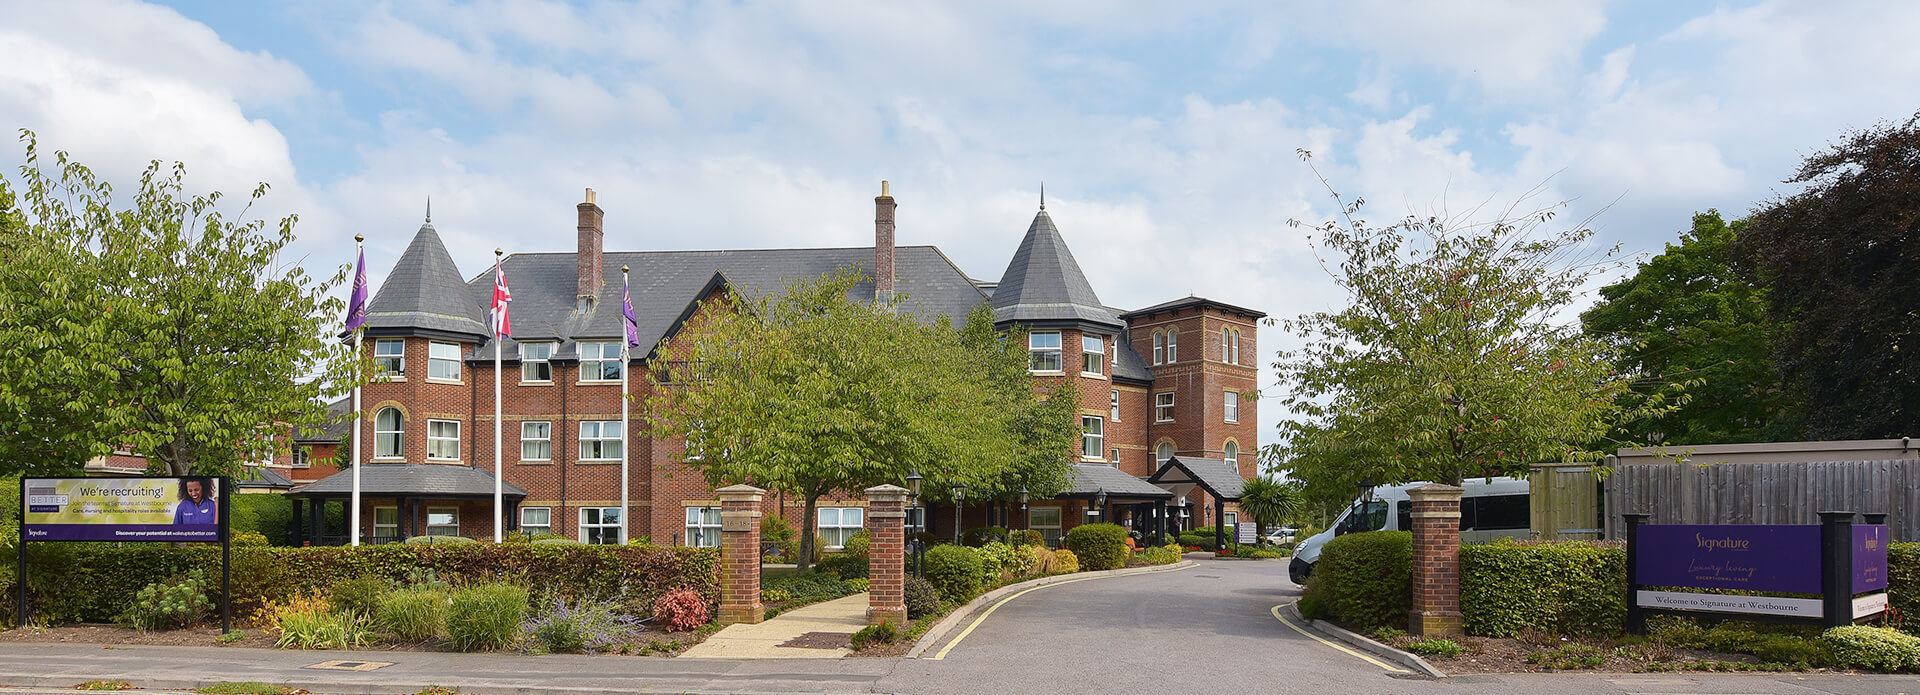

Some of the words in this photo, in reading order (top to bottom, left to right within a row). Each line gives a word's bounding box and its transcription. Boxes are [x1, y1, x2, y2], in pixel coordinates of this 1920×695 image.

[80, 487, 109, 497] We're
[111, 486, 164, 499] recruiting!
[31, 496, 67, 504] BETTER
[28, 528, 47, 537] Signature
[1696, 532, 1749, 552] Signature
[1655, 596, 1688, 605] Welcome
[1700, 598, 1736, 609] Signature
[1748, 601, 1799, 612] Westbourne
